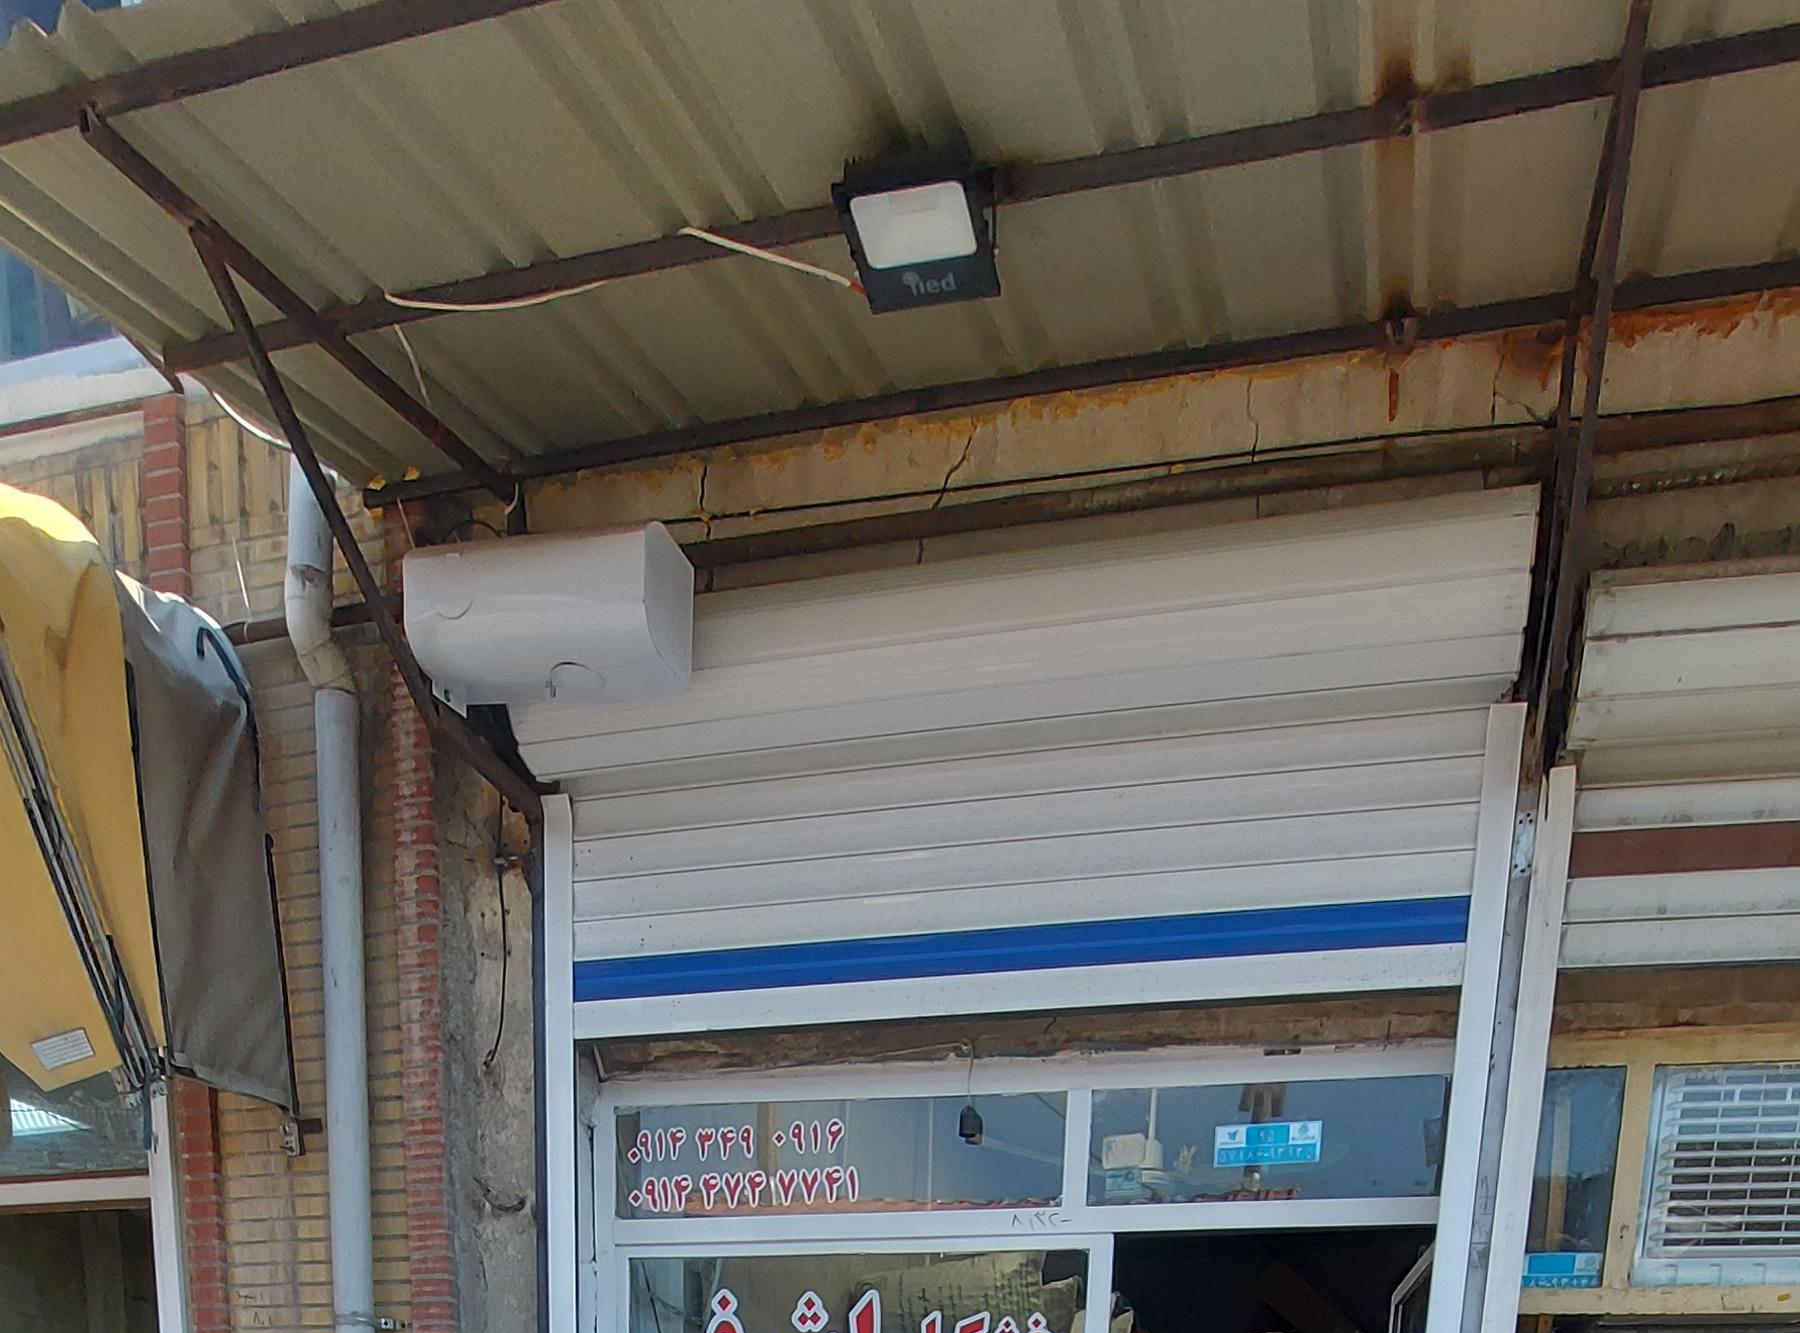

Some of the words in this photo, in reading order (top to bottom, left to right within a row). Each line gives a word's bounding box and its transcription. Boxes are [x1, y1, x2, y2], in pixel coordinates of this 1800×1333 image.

[628, 1127, 686, 1163] ۰۹۱۴
[695, 1125, 754, 1161] ۳۴۹
[772, 1118, 844, 1153] ۰۹۱۶
[629, 1174, 693, 1212] ۰۹۱۴
[700, 1170, 766, 1209] ۴۷۴
[777, 1166, 860, 1206] ۷۷۴۱
